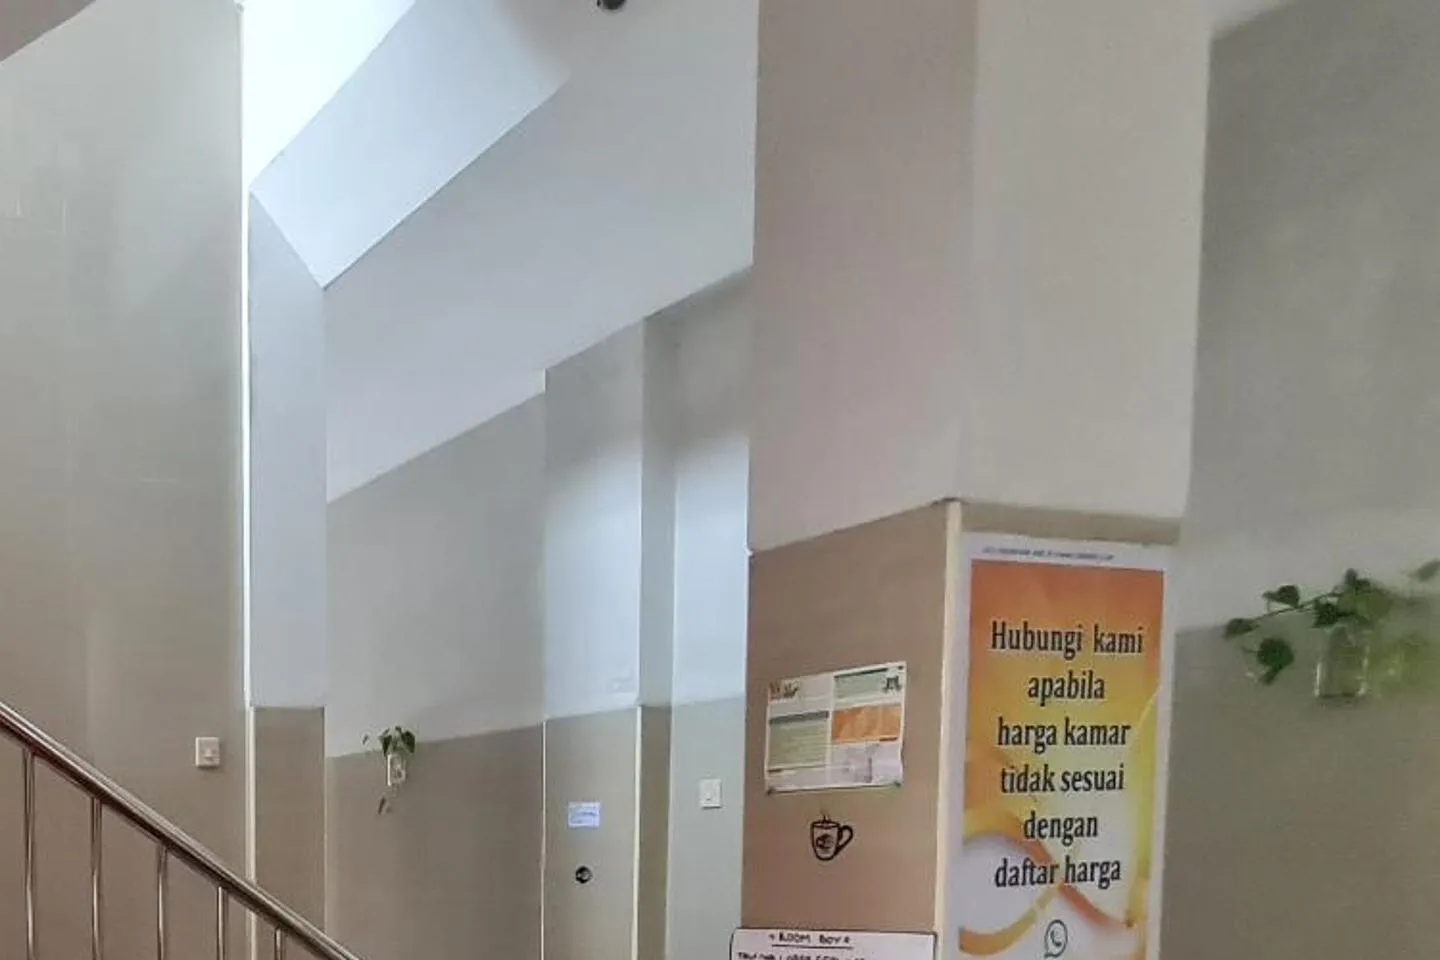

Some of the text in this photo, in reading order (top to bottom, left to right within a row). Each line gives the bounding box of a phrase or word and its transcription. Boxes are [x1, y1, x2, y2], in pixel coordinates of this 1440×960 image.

[991, 619, 1144, 660] Hubungi kami
[1027, 669, 1106, 707] apabila
[997, 716, 1132, 754] harga kamar
[1000, 763, 1125, 793] tidak sesuai
[1022, 810, 1099, 846] dengan
[994, 855, 1122, 889] daftar harga
